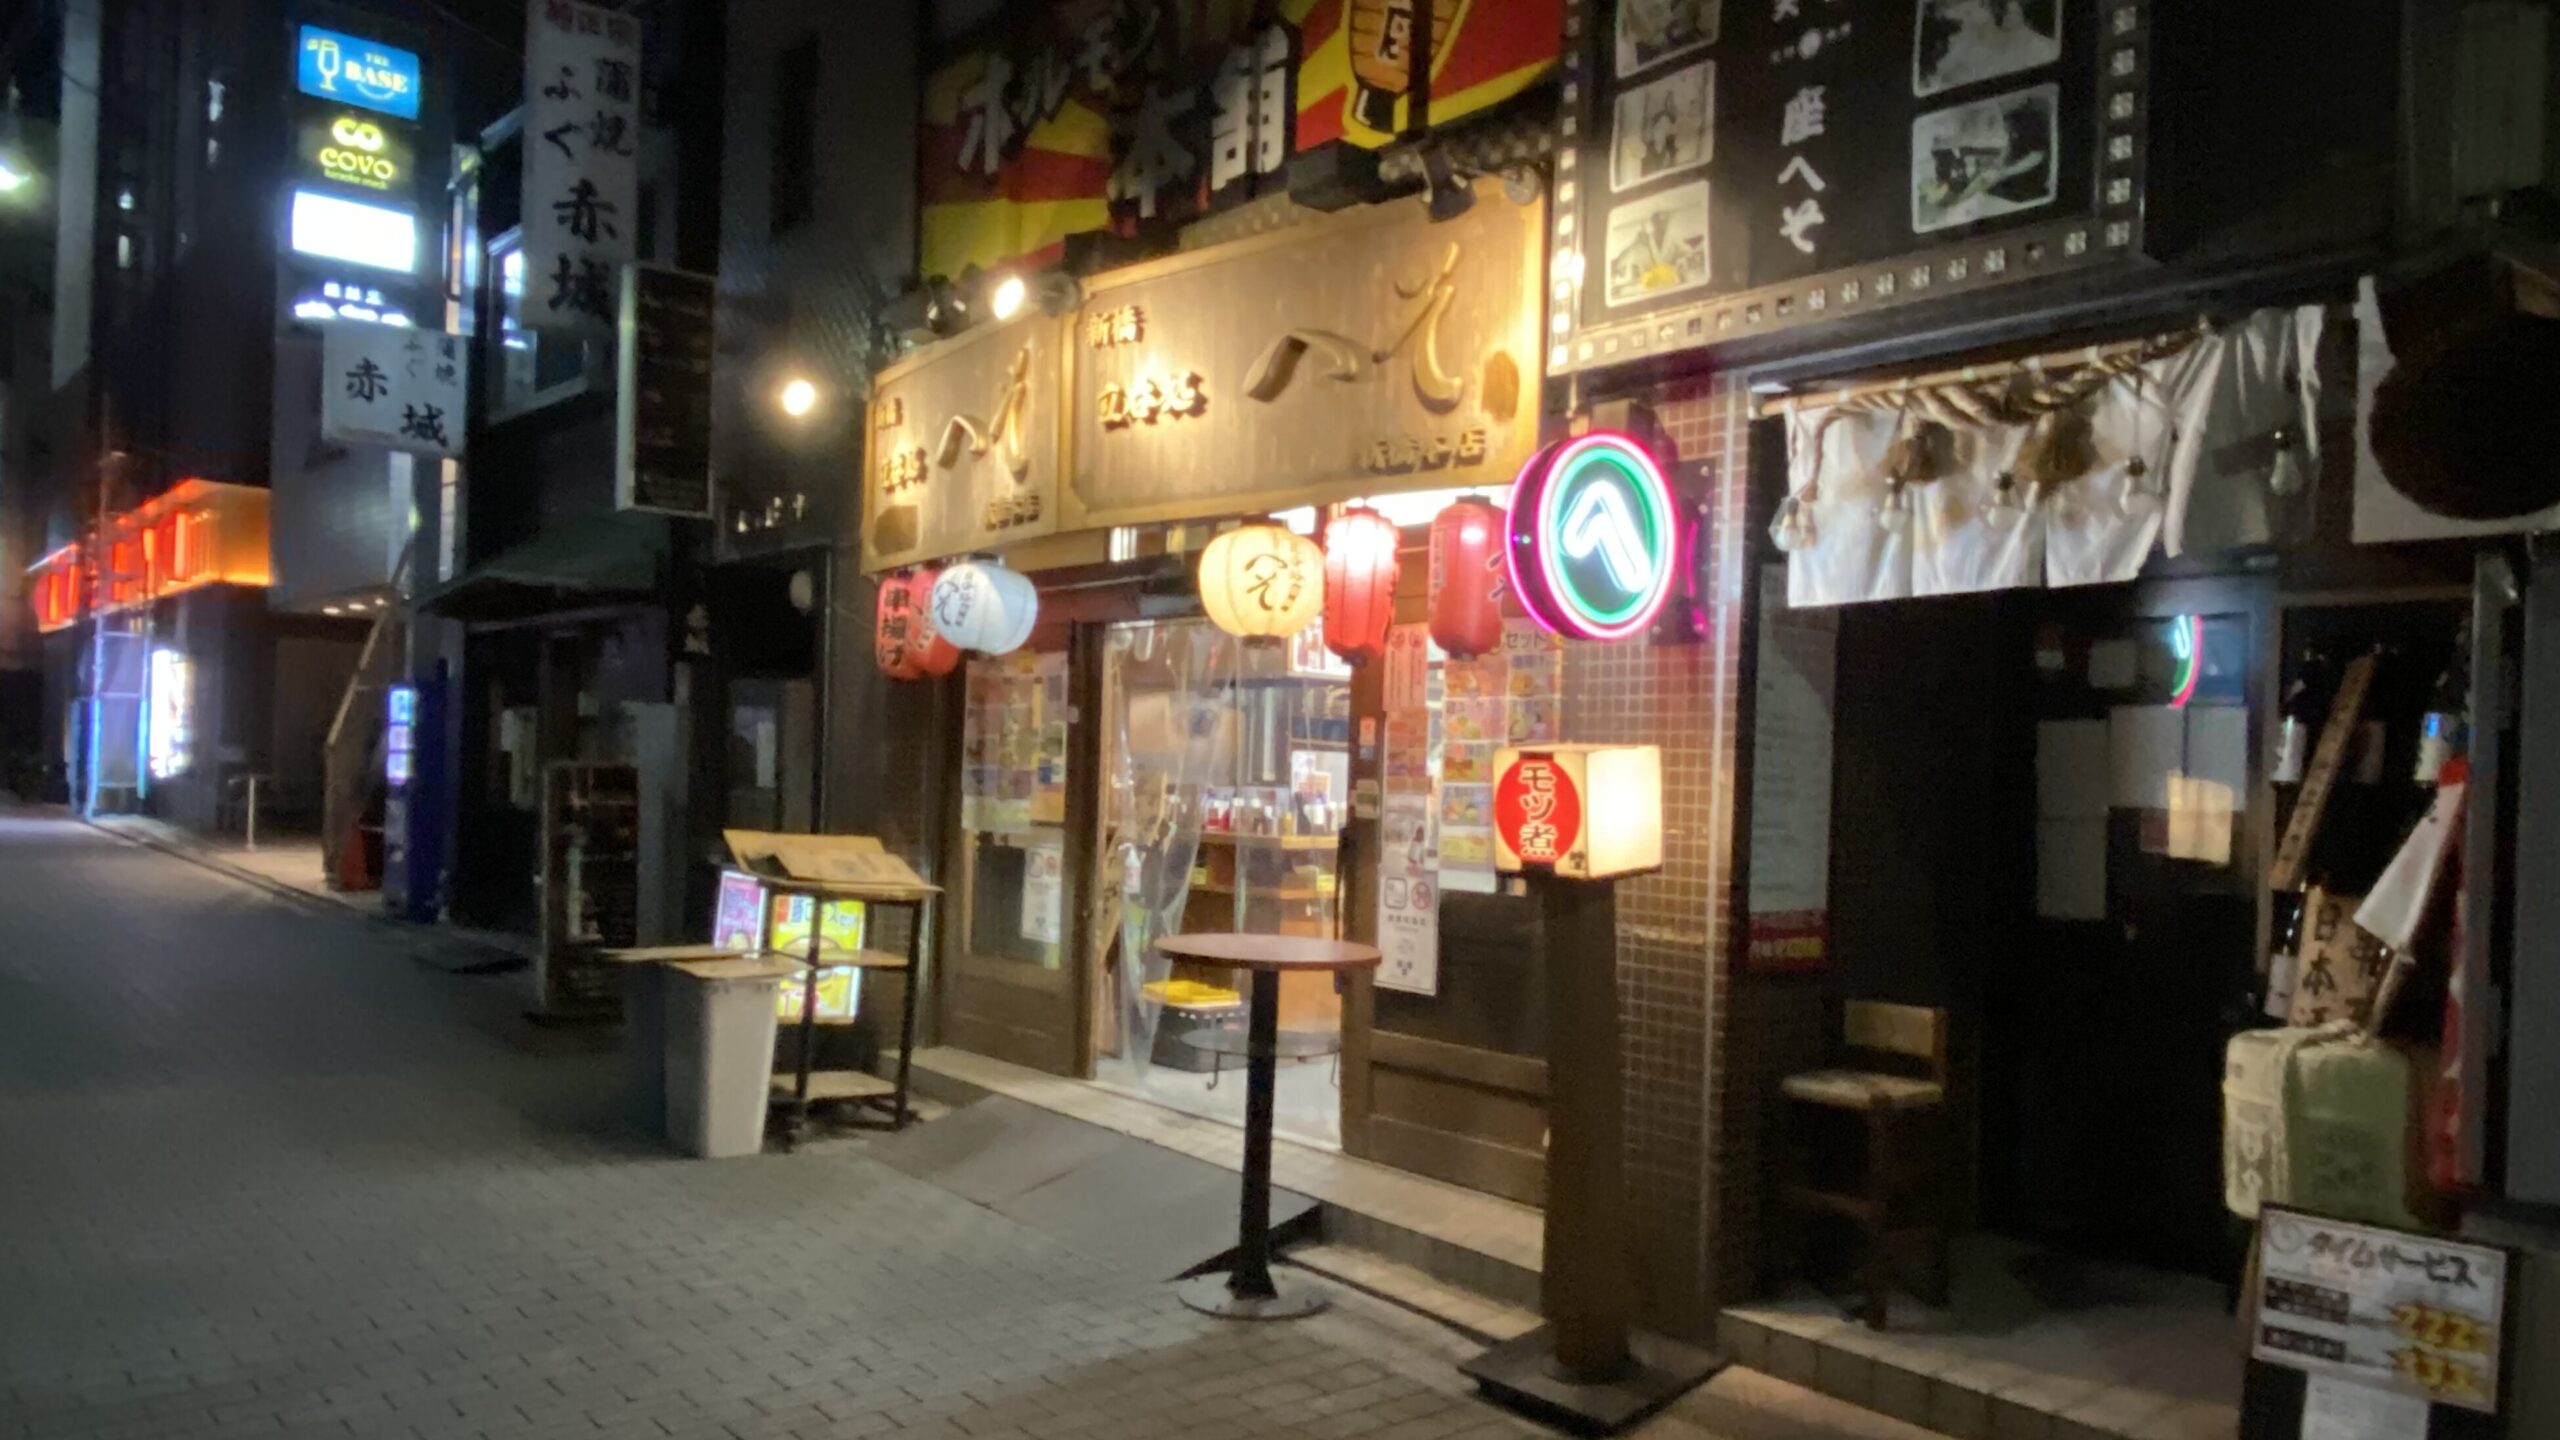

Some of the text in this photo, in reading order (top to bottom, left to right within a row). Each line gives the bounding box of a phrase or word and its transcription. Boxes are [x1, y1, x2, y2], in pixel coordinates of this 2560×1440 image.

[345, 60, 408, 93] BASE
[319, 146, 396, 180] COVO
[548, 176, 619, 328] 赤城
[1243, 240, 1465, 410] へそ
[345, 356, 449, 448] 赤城
[937, 343, 1032, 485] へそ
[1244, 553, 1288, 612] へそ
[1563, 481, 1650, 592] へ
[1506, 629, 1546, 650] セット
[1520, 764, 1557, 858] モツ煮
